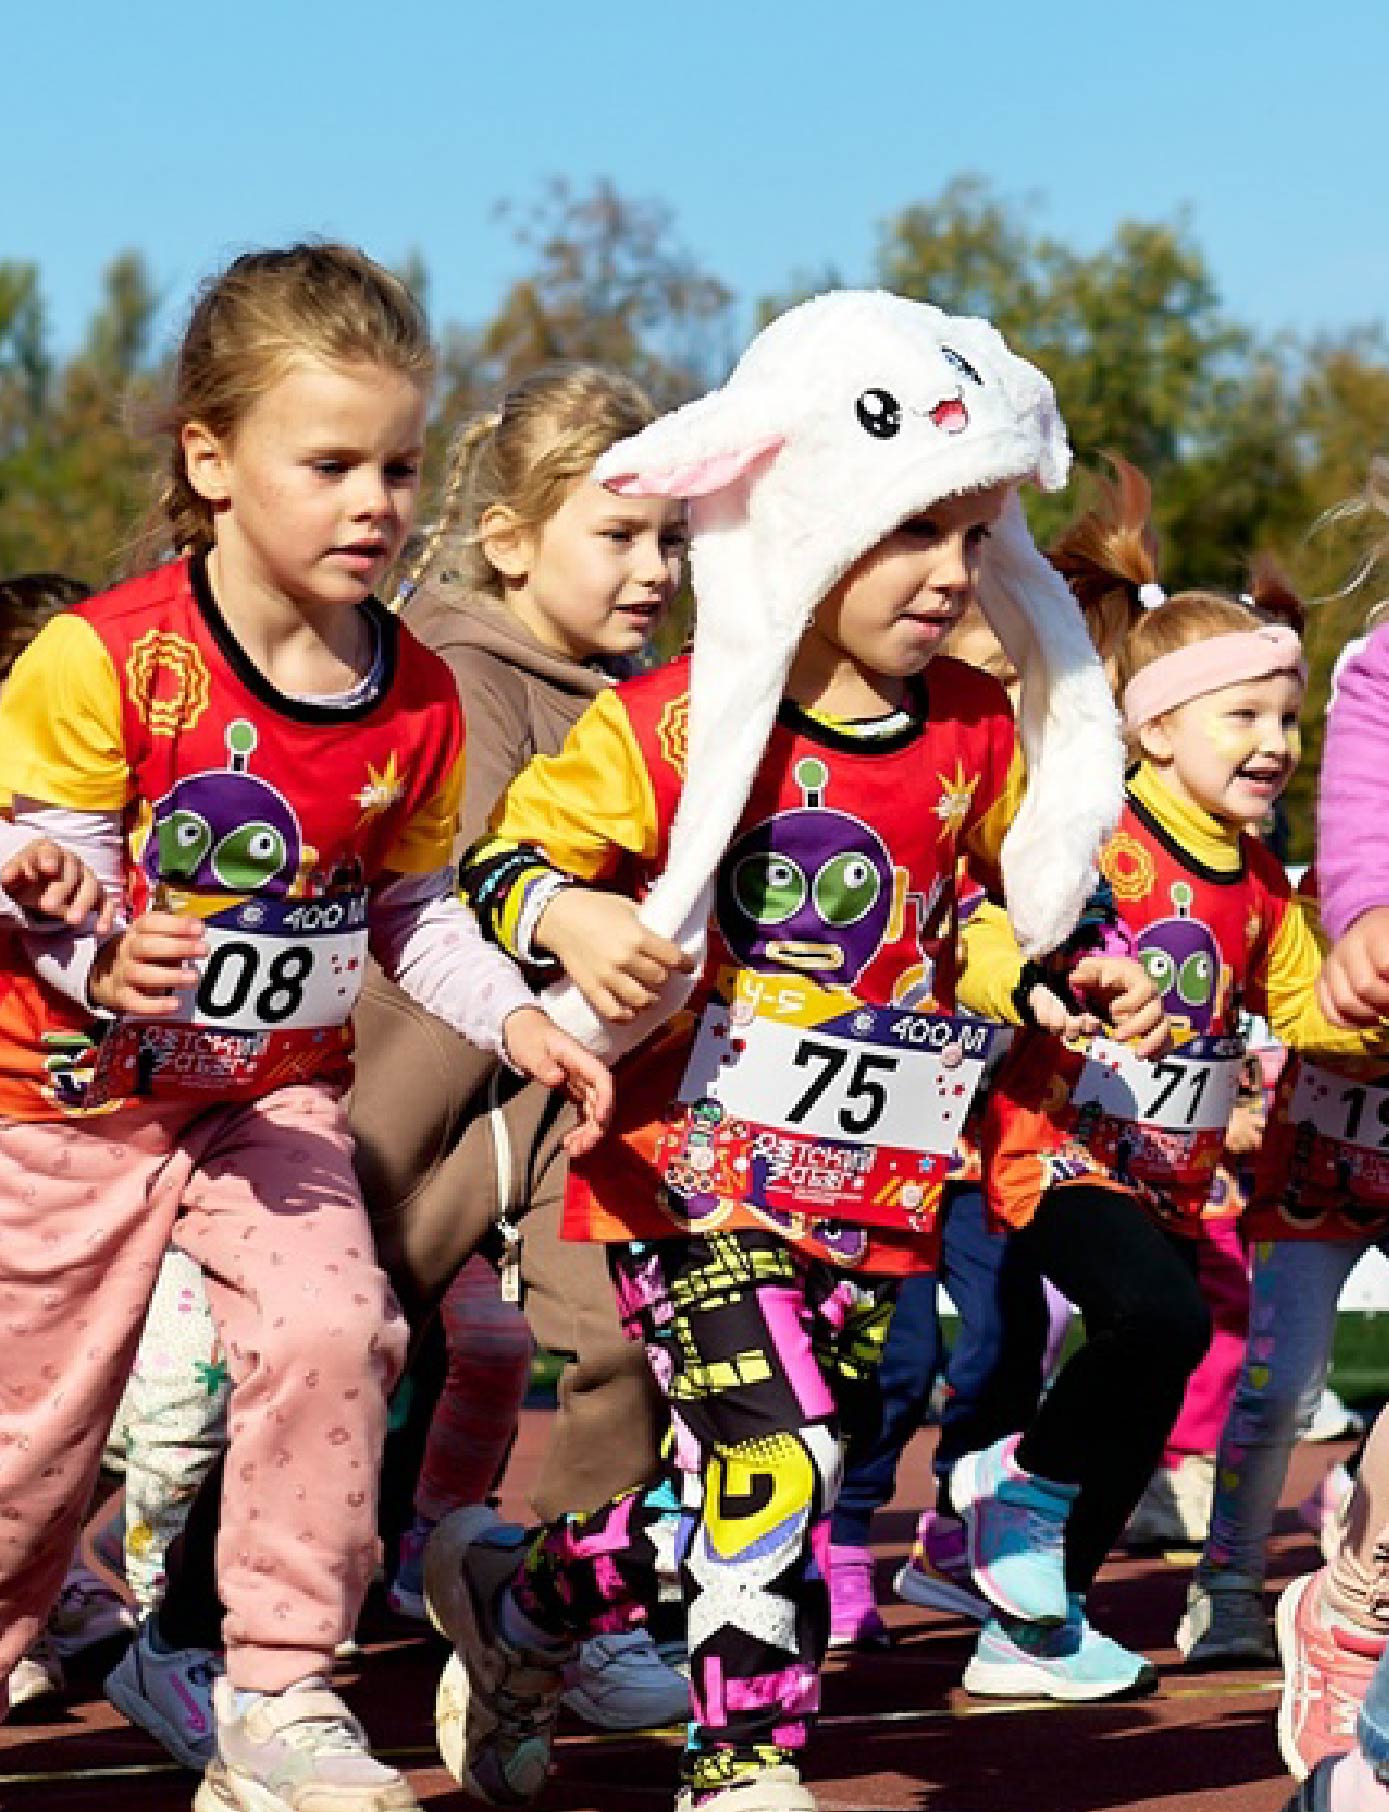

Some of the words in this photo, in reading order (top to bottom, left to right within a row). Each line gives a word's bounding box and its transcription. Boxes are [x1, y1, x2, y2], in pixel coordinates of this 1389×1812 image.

[282, 903, 344, 931] 400
[740, 972, 806, 1013] 4-5
[890, 1016, 951, 1043] 400
[784, 1038, 901, 1135] 75
[1143, 1063, 1211, 1125] 71
[751, 1132, 878, 1174] ДЕТСКИЙ
